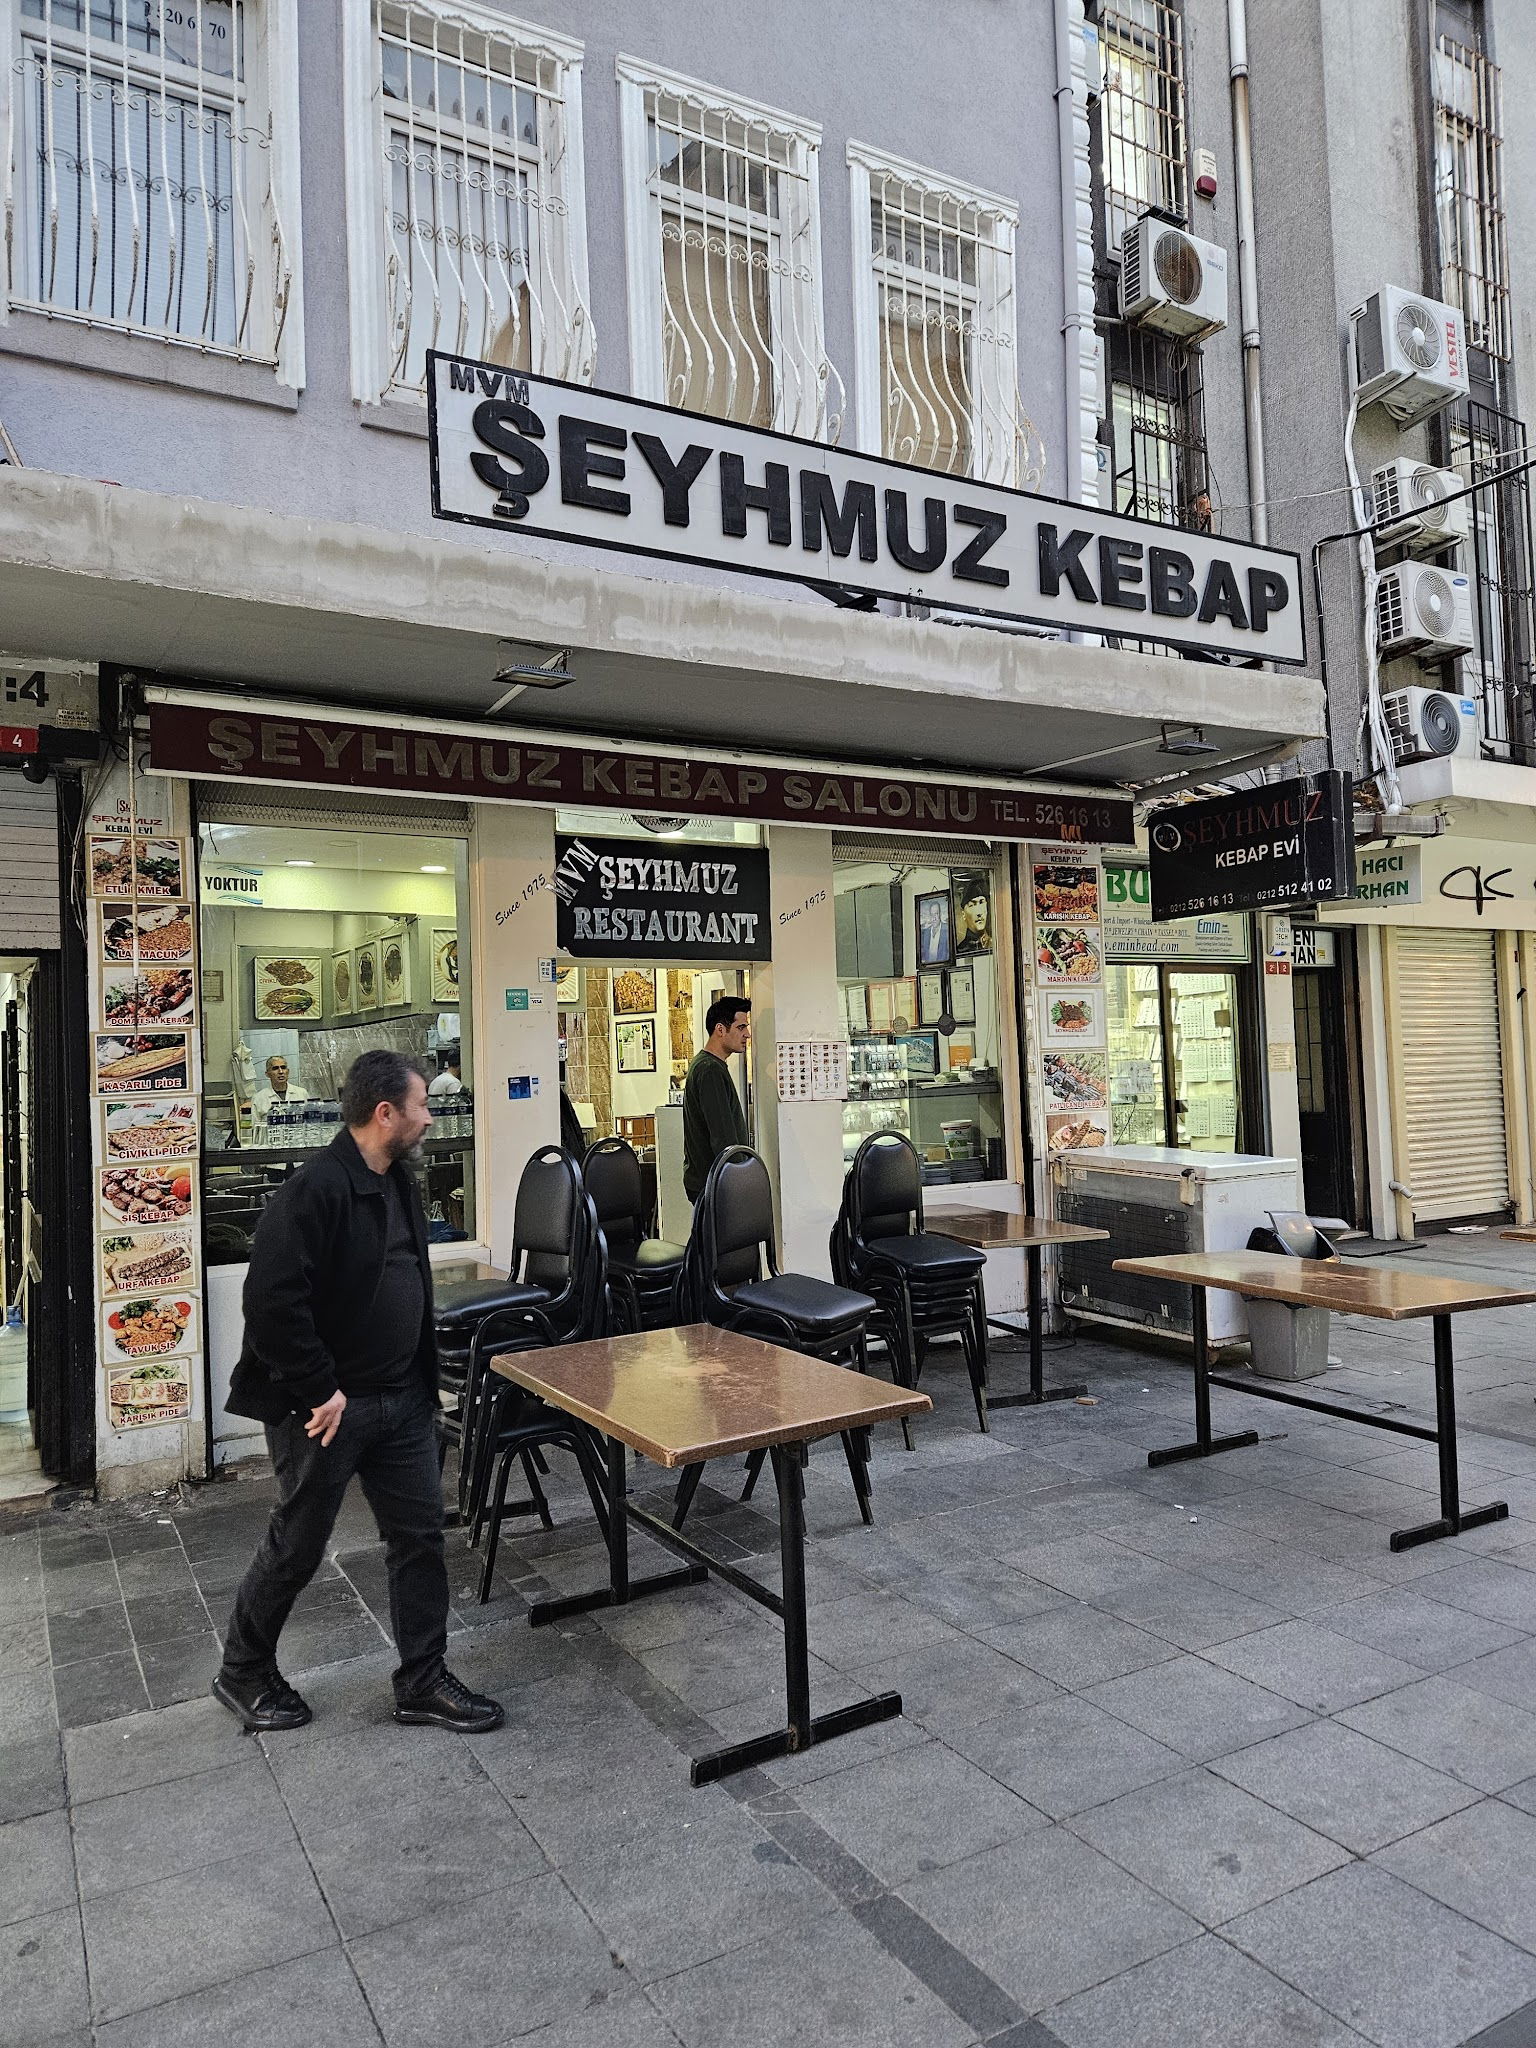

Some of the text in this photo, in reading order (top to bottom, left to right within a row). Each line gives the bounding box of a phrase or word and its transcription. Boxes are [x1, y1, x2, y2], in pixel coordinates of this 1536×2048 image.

[208, 22, 226, 39] 70
[1446, 320, 1458, 377] VESTEL
[450, 363, 529, 405] MVM
[470, 399, 1289, 633] ŞEYHMUZ KEBAP
[12, 734, 22, 748] 4
[207, 717, 1111, 829] ŞEYHMUZ KEBAP SALONU TEL. 526 16 13
[105, 825, 132, 834] KEBA
[1184, 789, 1323, 853] ŞEYHMUZ
[1216, 834, 1299, 868] KEBAP EVİ
[1362, 856, 1403, 876] HACI
[205, 877, 258, 892] YOKTUR
[545, 838, 600, 906] MVM
[599, 856, 739, 900] ŞEYHMUZ
[495, 873, 546, 925] Since 1975
[779, 890, 827, 925] Since 1975
[1188, 898, 1205, 910] 526
[1208, 895, 1219, 906] 16
[1222, 893, 1234, 904] 13
[1257, 889, 1276, 900] 0212
[1278, 883, 1298, 896] 512
[1301, 881, 1314, 893] 41
[1318, 878, 1332, 891] 02
[573, 907, 759, 944] RESTAURANT
[1198, 919, 1220, 934] Emin
[119, 950, 178, 960] LAMACUN
[104, 1077, 182, 1092] KAŞARLI PİDE
[140, 1210, 174, 1221] KEBAP
[118, 1275, 180, 1290] URFA KEBAP
[126, 1344, 158, 1355] TAVUK
